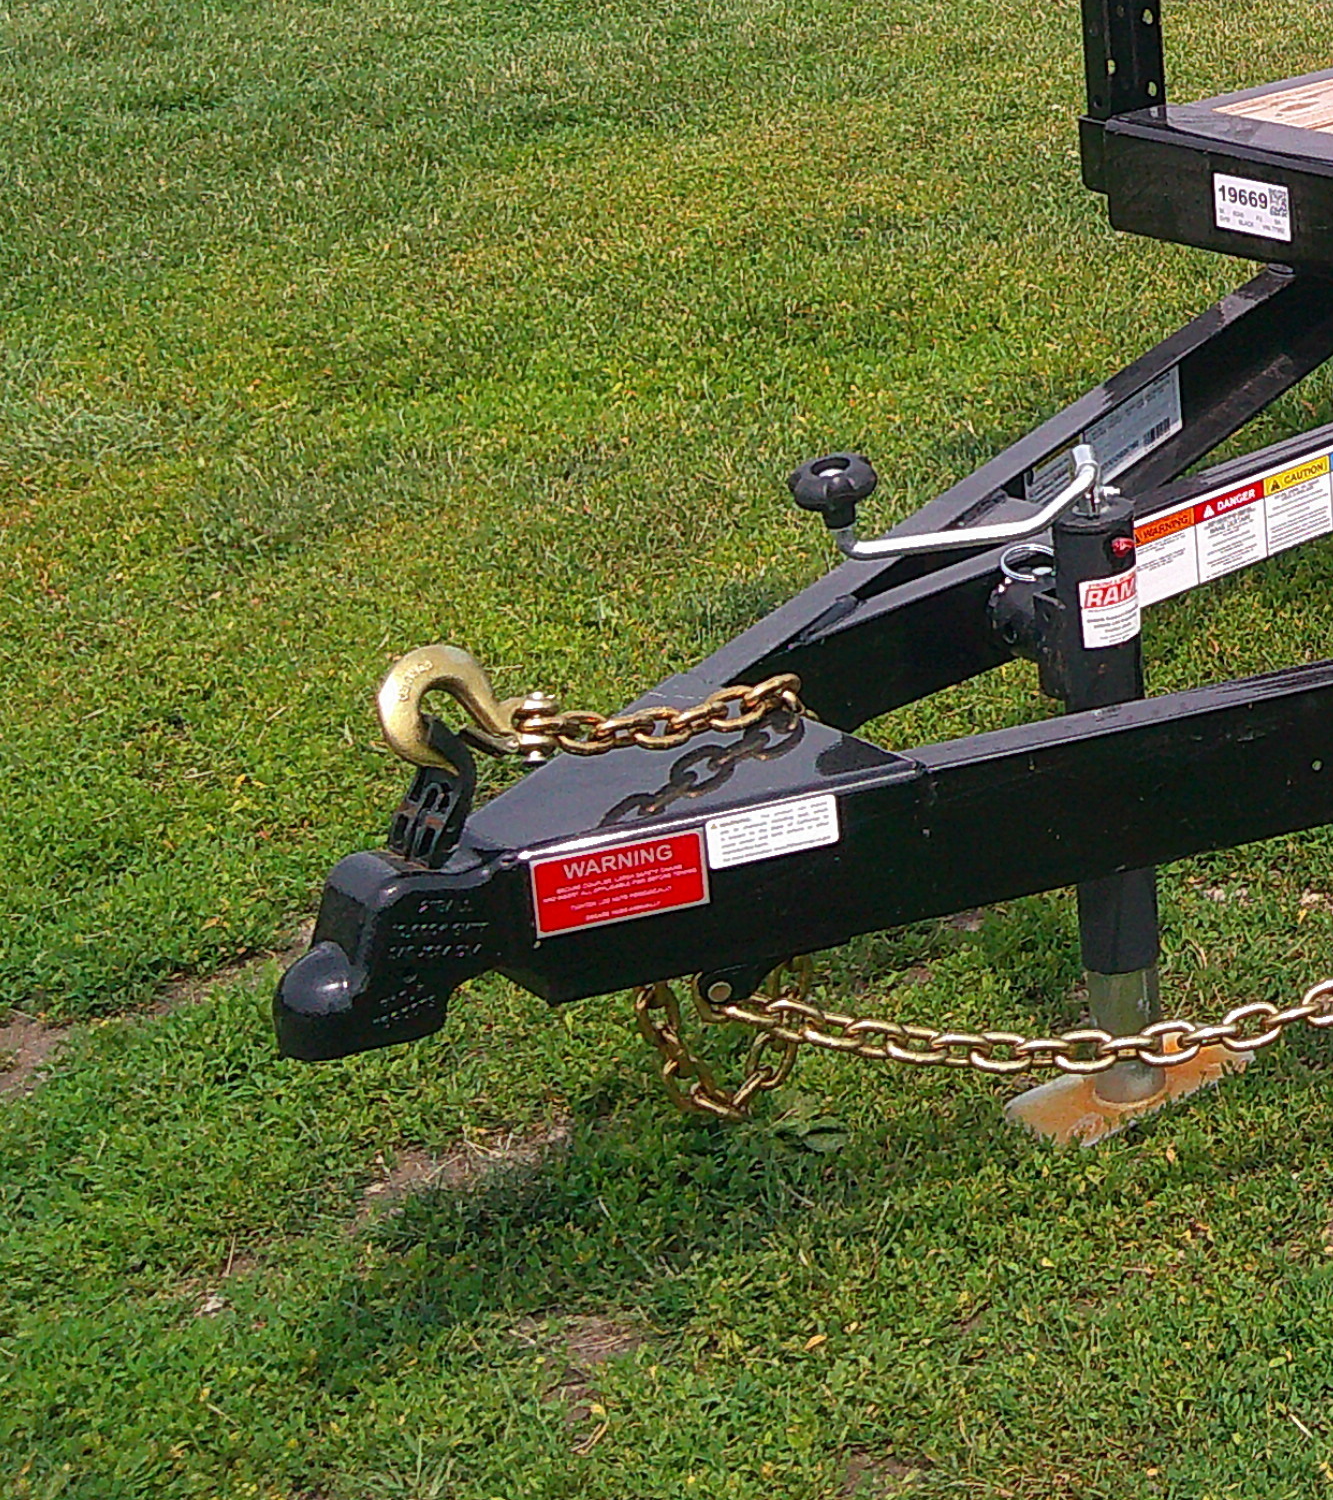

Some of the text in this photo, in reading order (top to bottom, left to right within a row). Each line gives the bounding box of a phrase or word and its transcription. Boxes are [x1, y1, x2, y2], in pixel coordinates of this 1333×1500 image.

[1218, 184, 1269, 210] 19669
[1283, 462, 1324, 485] CAUTION
[1217, 488, 1256, 512] DANGER
[1143, 514, 1188, 539] WARNING
[563, 843, 674, 880] WARNING
